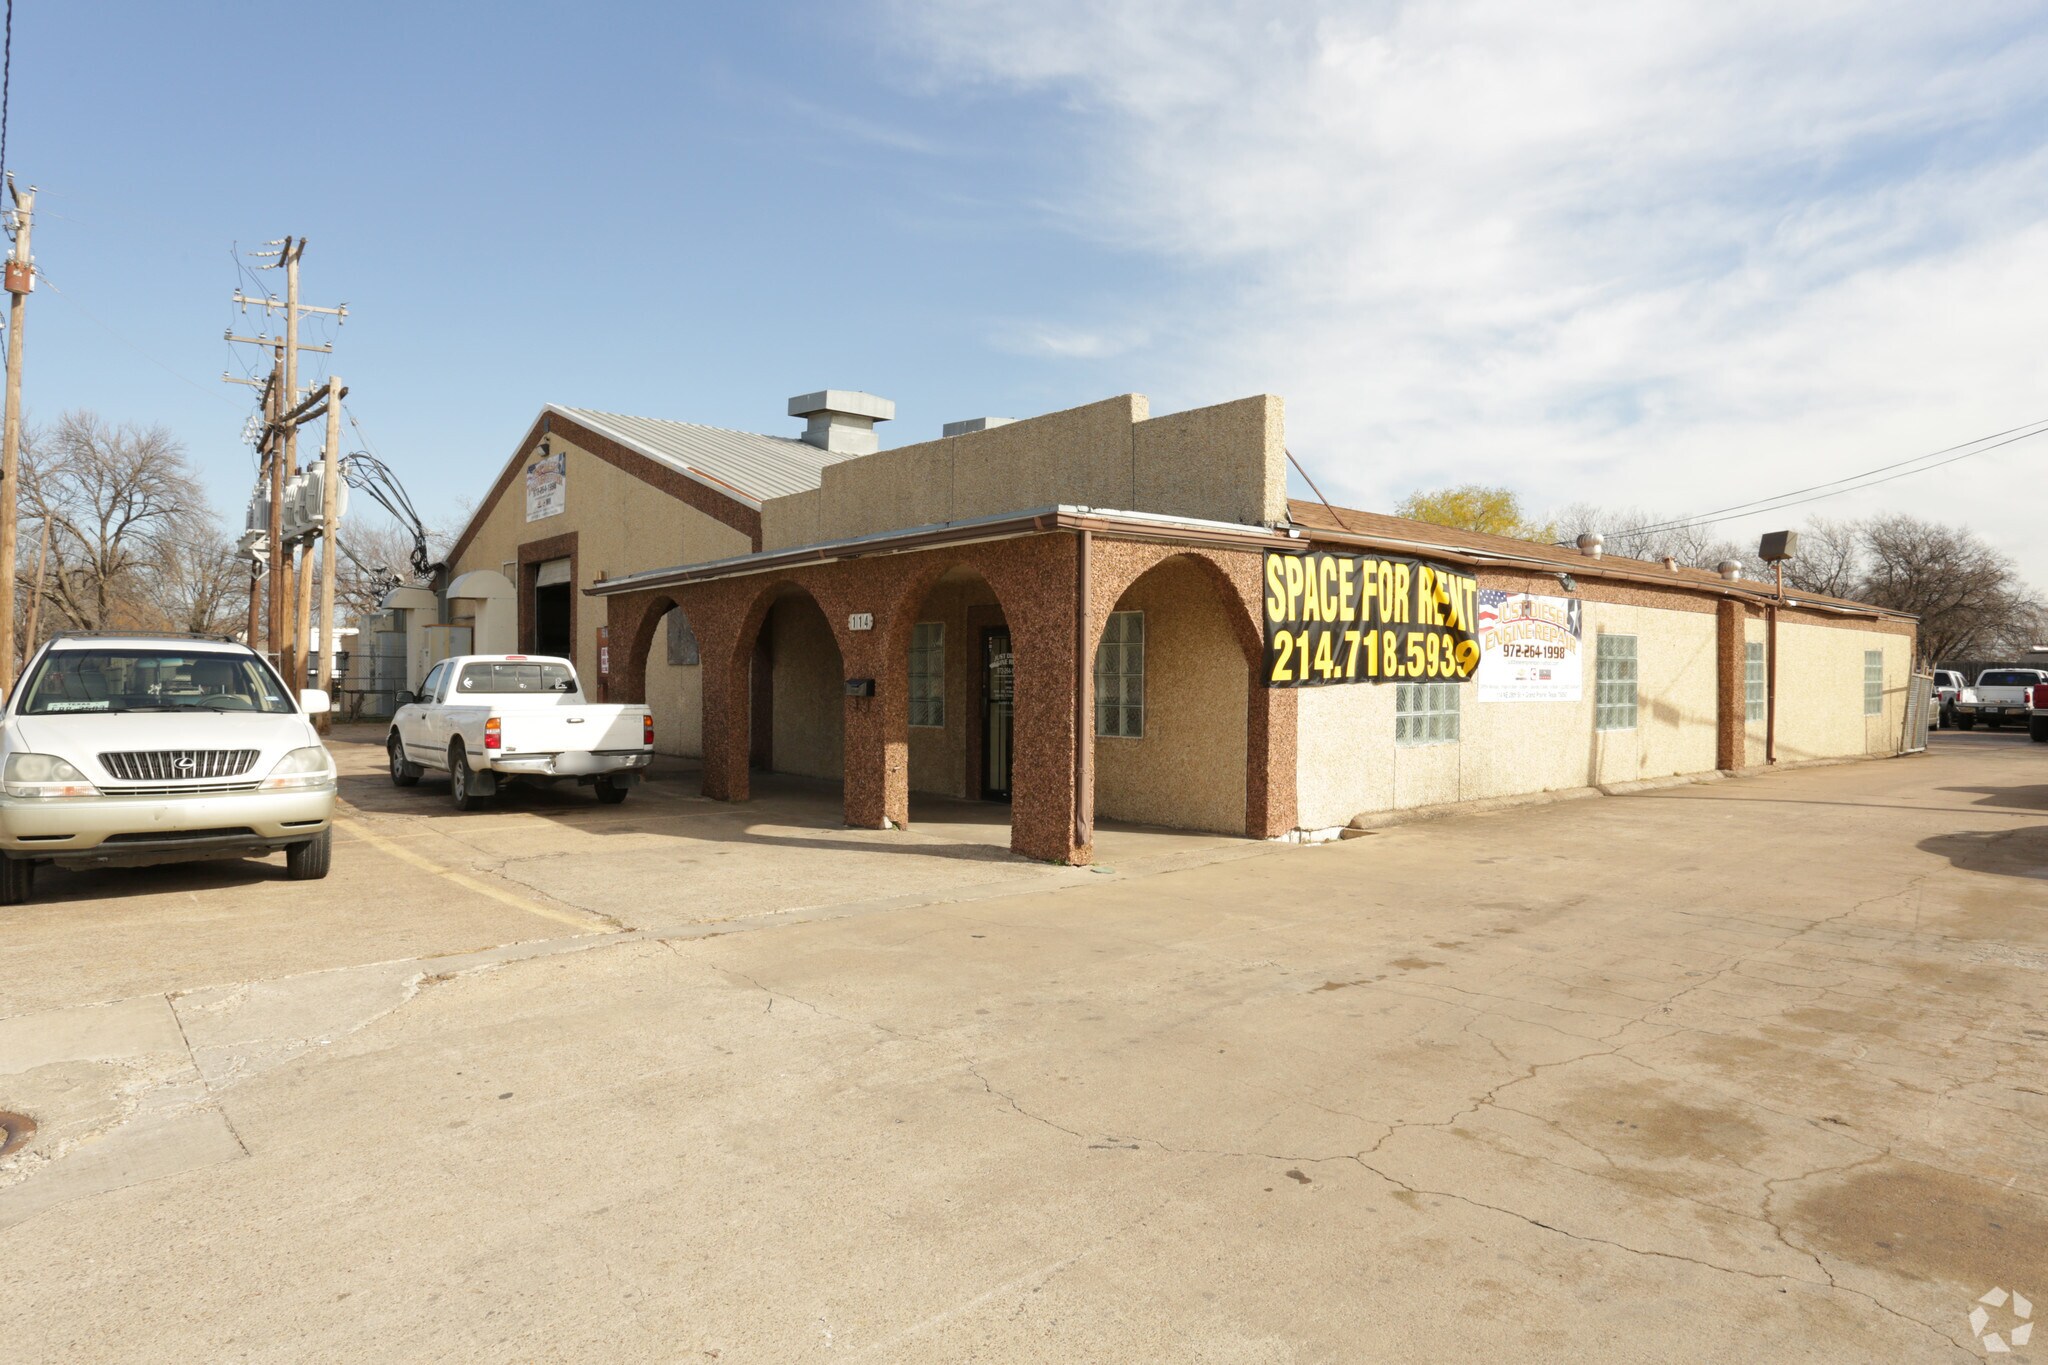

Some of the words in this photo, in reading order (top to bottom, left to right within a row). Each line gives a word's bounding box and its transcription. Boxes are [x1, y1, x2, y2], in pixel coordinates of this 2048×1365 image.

[1266, 553, 1354, 622] SPACE
[1361, 560, 1410, 624] FOR
[1418, 565, 1477, 634] RENT
[852, 615, 868, 628] 114
[1496, 601, 1526, 624] JUST
[1530, 600, 1570, 629] DIESEL
[1485, 622, 1532, 651] ENGINE
[1534, 623, 1577, 655] REPAIR
[1503, 644, 1565, 659] 972-264-1998
[1271, 629, 1480, 681] 214.718.5939
